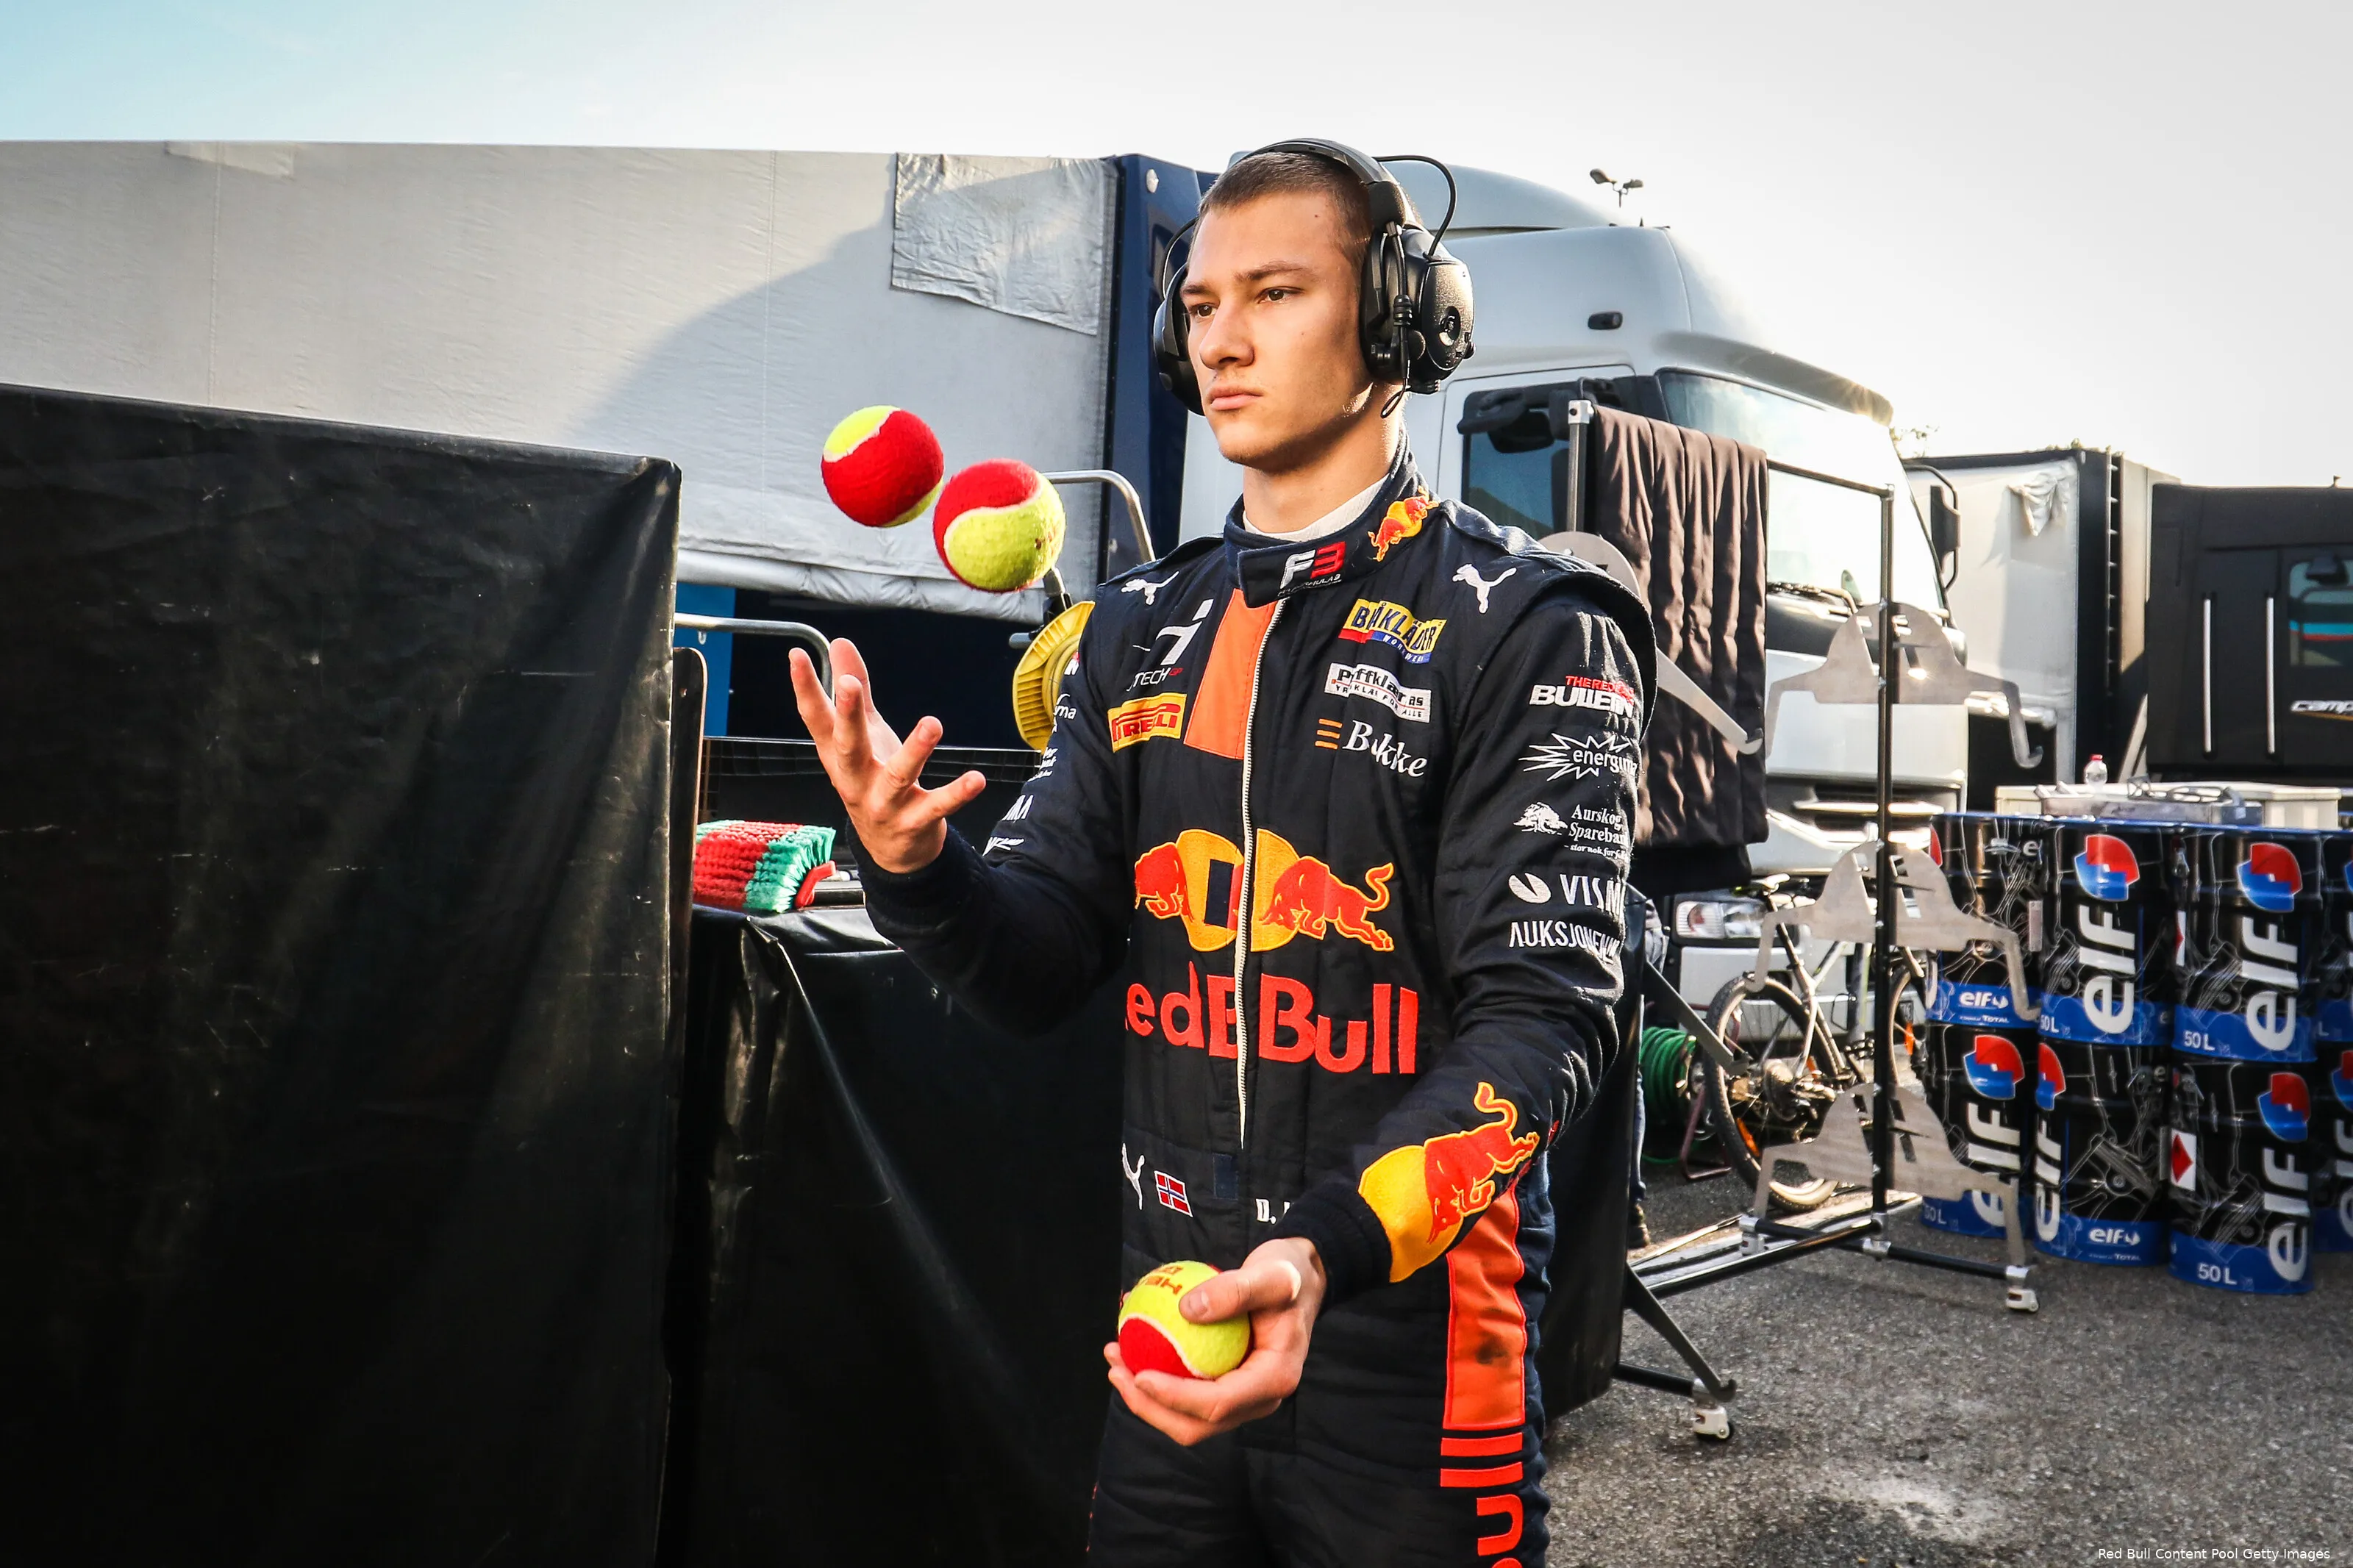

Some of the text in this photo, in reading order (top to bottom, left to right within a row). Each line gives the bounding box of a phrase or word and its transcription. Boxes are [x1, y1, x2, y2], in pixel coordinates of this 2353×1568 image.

[1279, 541, 1346, 590] F3
[1351, 602, 1437, 651] BÅKLÄDER
[1111, 703, 1182, 742] PIRELI
[1342, 720, 1428, 777] Bkke
[1568, 822, 1629, 848] Spareban
[1571, 804, 1624, 831] Aurskog
[2079, 903, 2136, 1035] elf
[2242, 916, 2299, 1052] elf
[1960, 991, 1993, 1008] elf
[1982, 1014, 2010, 1024] TOTAL
[2183, 1030, 2215, 1050] 50 L
[2263, 1147, 2310, 1282] elf
[2089, 1228, 2125, 1245] elf
[2197, 1262, 2238, 1286] 50 L
[1440, 1432, 1524, 1568] ull
